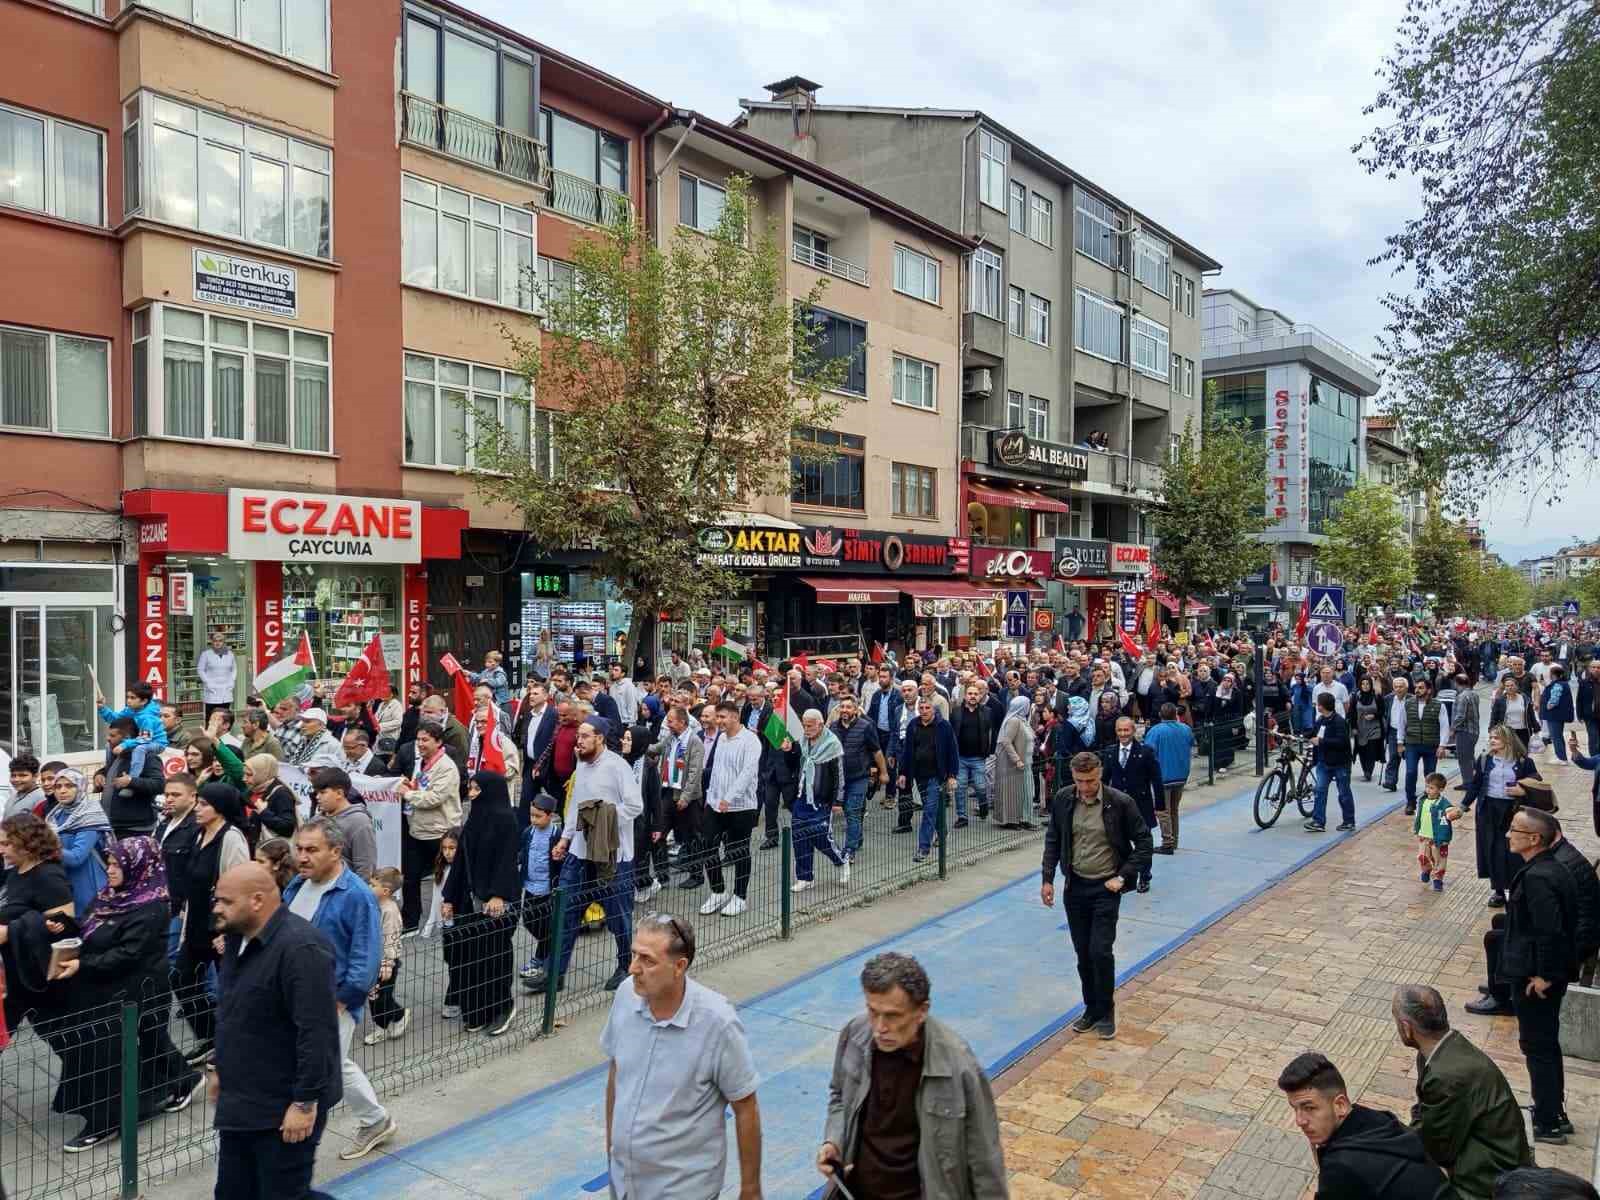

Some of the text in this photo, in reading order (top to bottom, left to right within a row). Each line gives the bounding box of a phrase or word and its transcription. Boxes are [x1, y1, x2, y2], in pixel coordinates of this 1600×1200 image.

[217, 258, 290, 289] pirenkuş
[223, 285, 236, 296] ARAÇ
[1049, 449, 1088, 470] BEAUTY
[243, 497, 413, 541] ECZANE
[140, 522, 168, 550] ECZANE
[736, 530, 800, 552] AKTAR
[288, 540, 373, 562] ÇAYCUMA
[741, 552, 766, 567] DOĞAL
[768, 555, 801, 567] ÜRÜNLER
[844, 538, 882, 561] SİMİT
[1116, 547, 1150, 562] ECZANE
[1118, 582, 1146, 595] ECZANE
